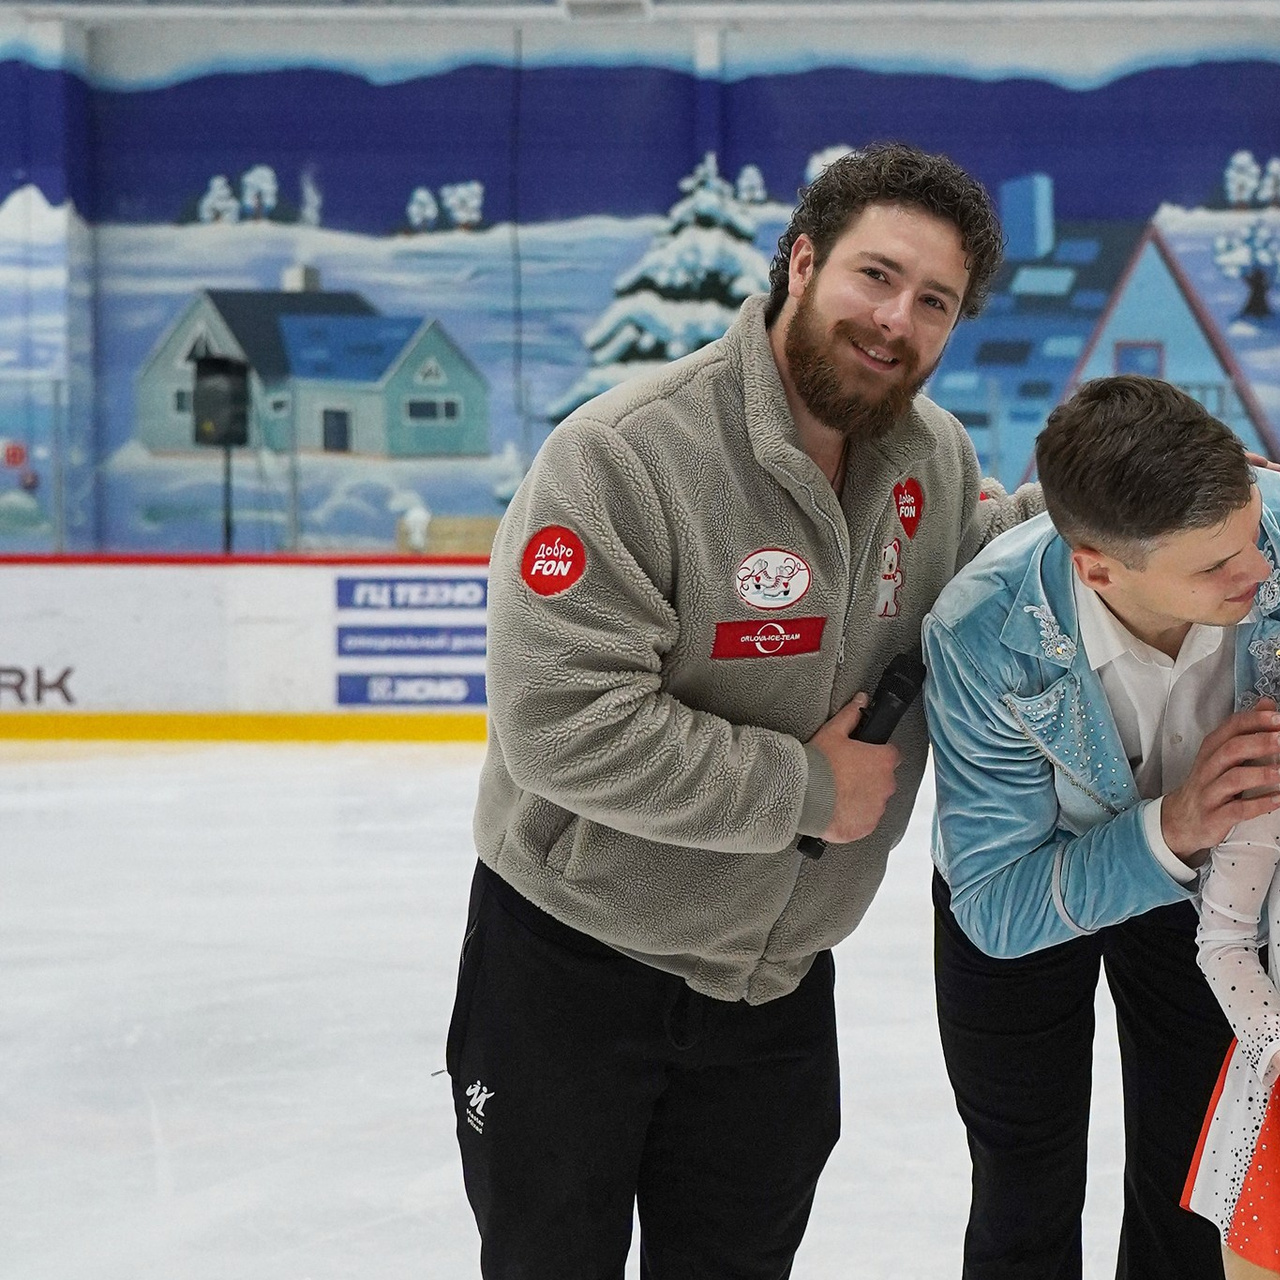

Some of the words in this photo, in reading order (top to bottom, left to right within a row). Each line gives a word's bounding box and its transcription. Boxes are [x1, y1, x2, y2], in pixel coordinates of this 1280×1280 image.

[899, 505, 916, 518] FON
[534, 537, 574, 560] Добро
[530, 559, 573, 577] FON
